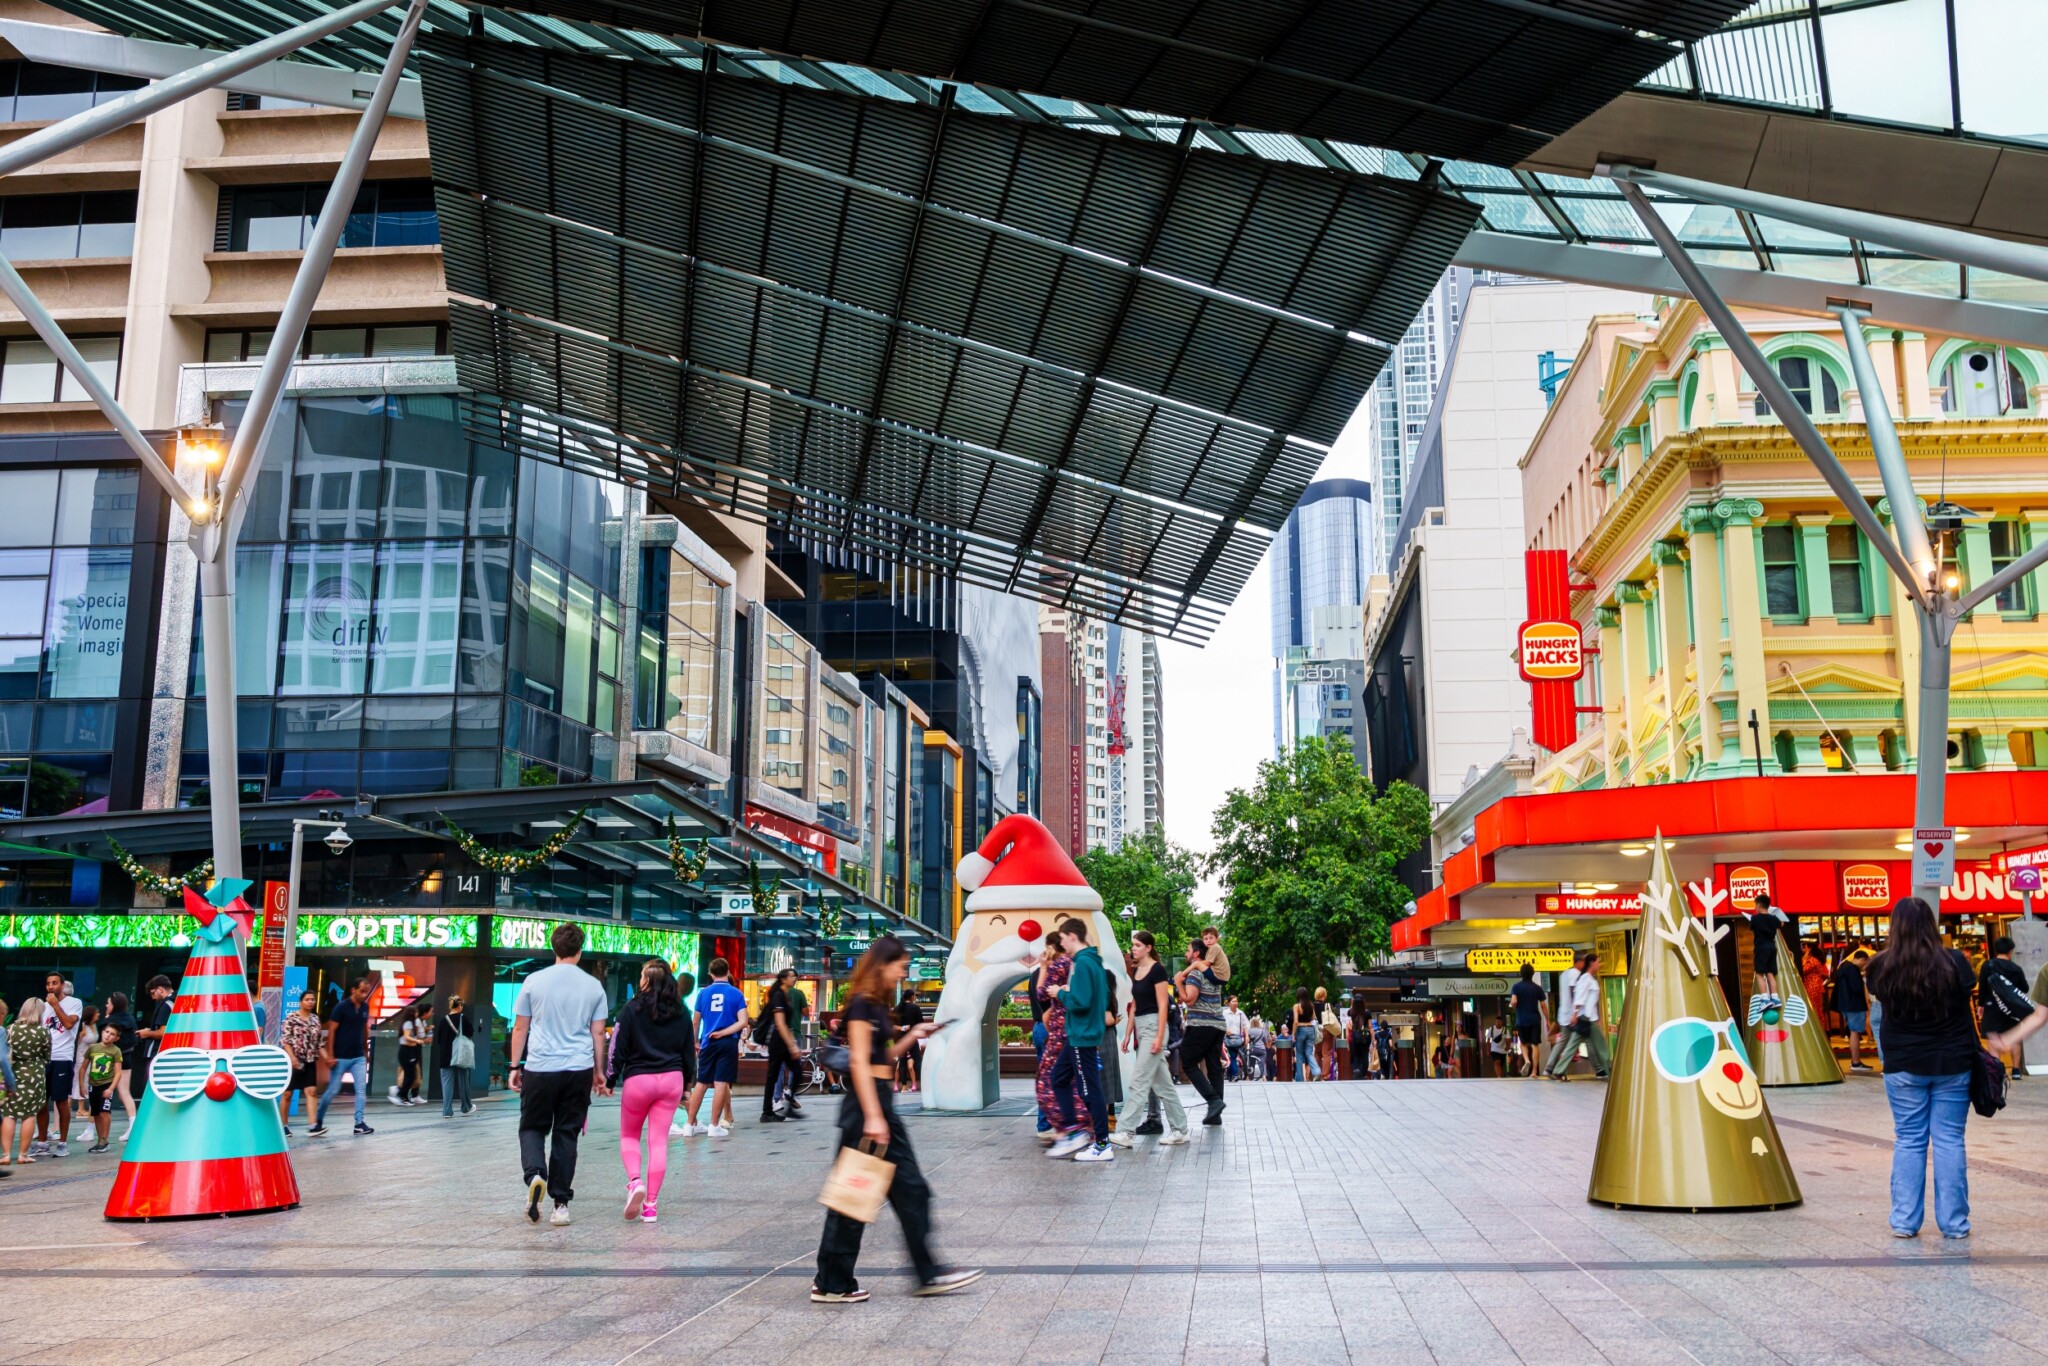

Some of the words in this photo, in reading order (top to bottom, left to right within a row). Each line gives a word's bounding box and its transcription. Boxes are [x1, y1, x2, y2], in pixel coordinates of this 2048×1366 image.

[79, 615, 124, 631] Wome
[1525, 638, 1578, 650] HUNGRY
[1526, 650, 1579, 665] JACK'S
[1294, 664, 1347, 683] capri
[1918, 831, 1951, 839] RESERVED
[457, 875, 480, 893] 141
[500, 876, 511, 894] 141
[1731, 879, 1766, 888] HUNGRY
[1845, 878, 1887, 886] HUNGRY
[1847, 886, 1888, 898] JACK'S
[1566, 898, 1619, 910] HUNGRY
[328, 917, 451, 945] OPTUS
[502, 920, 546, 948] OPTUS
[1518, 949, 1572, 957] DIAMOND
[710, 993, 724, 1012] 2
